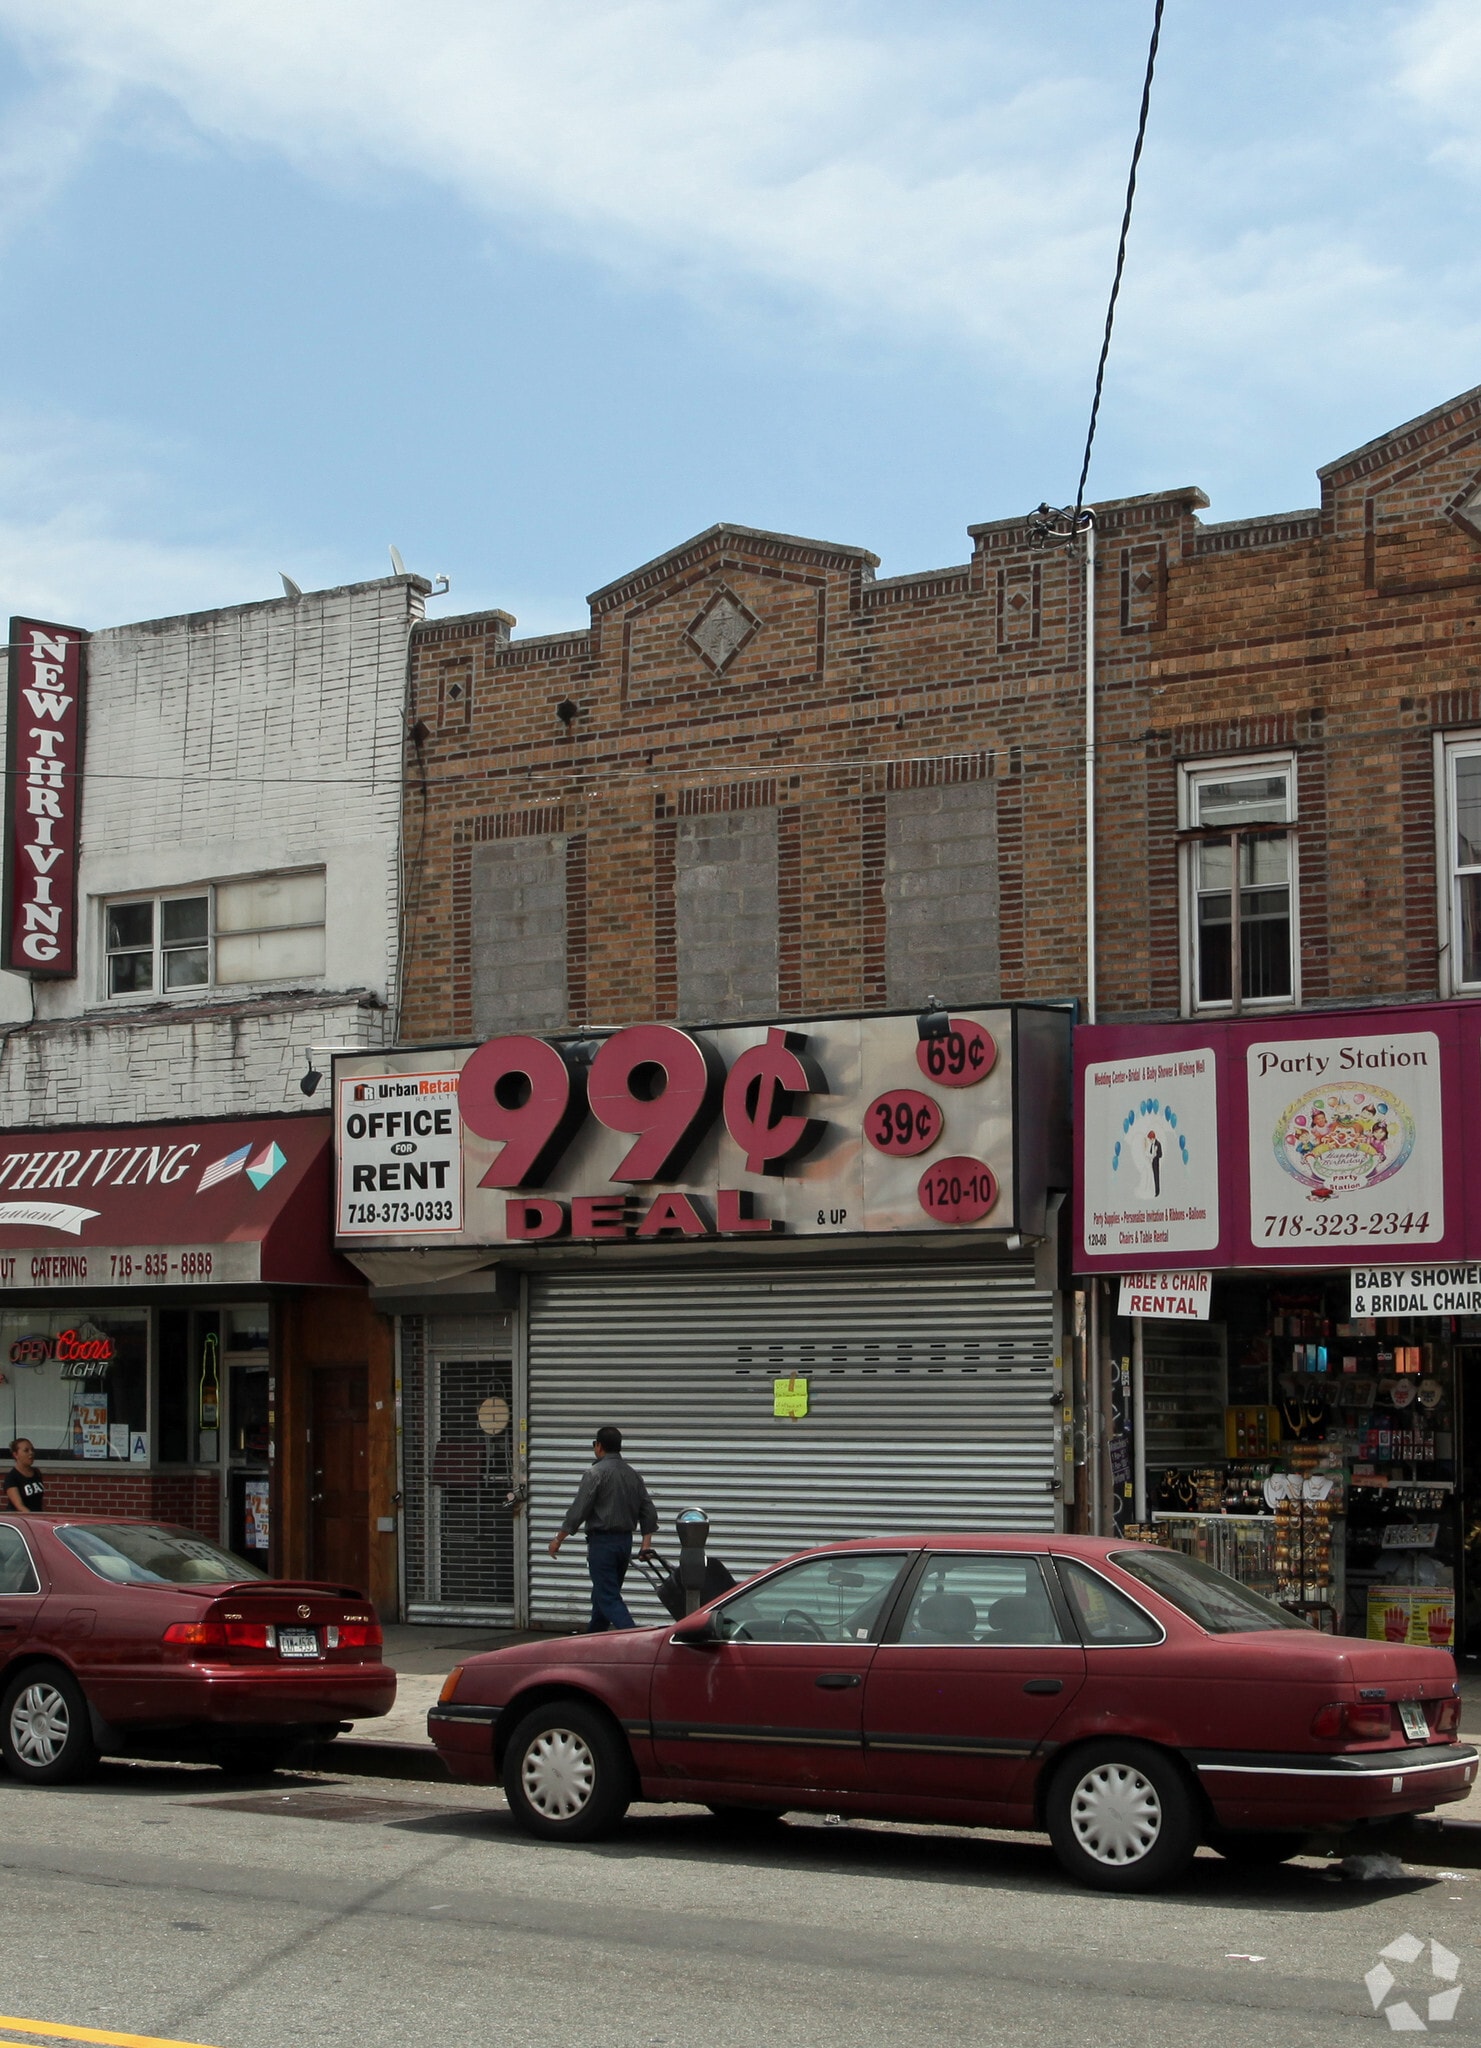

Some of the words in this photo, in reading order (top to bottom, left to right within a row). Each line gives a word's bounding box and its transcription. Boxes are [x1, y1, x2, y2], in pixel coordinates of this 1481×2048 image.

[22, 630, 73, 722] NEW
[22, 727, 66, 962] THRIVING
[926, 1032, 985, 1075] 69¢
[1257, 1051, 1330, 1076] Party
[1339, 1044, 1429, 1071] Station
[346, 1108, 453, 1139] OFFICE
[875, 1101, 932, 1146] 39¢
[395, 1143, 413, 1154] FOR
[0, 1143, 201, 1191] THRIVING
[352, 1160, 450, 1193] RENT
[924, 1174, 991, 1207] 120-10
[1330, 1183, 1361, 1191] Station
[348, 1200, 453, 1224] 718-373-0333
[505, 1189, 773, 1240] DEAL
[817, 1209, 828, 1226] &
[830, 1208, 848, 1226] UP
[1263, 1210, 1431, 1238] 718-323-2344
[0, 1258, 16, 1279] UT
[31, 1256, 87, 1278] CATERING
[111, 1252, 213, 1277] 718-835-8888
[1355, 1271, 1405, 1289] BABY
[1411, 1267, 1481, 1287] SHOWE
[1123, 1273, 1157, 1290] TABLE
[1160, 1274, 1168, 1290] &
[1172, 1272, 1207, 1291] CHAIR
[1130, 1295, 1198, 1315] RENTAL
[1355, 1295, 1366, 1313] &
[1372, 1293, 1428, 1313] BRIDAL
[9, 1340, 53, 1362] OPEN
[57, 1329, 113, 1361] Coors
[60, 1361, 109, 1377] LIGHT
[134, 1435, 146, 1454] A
